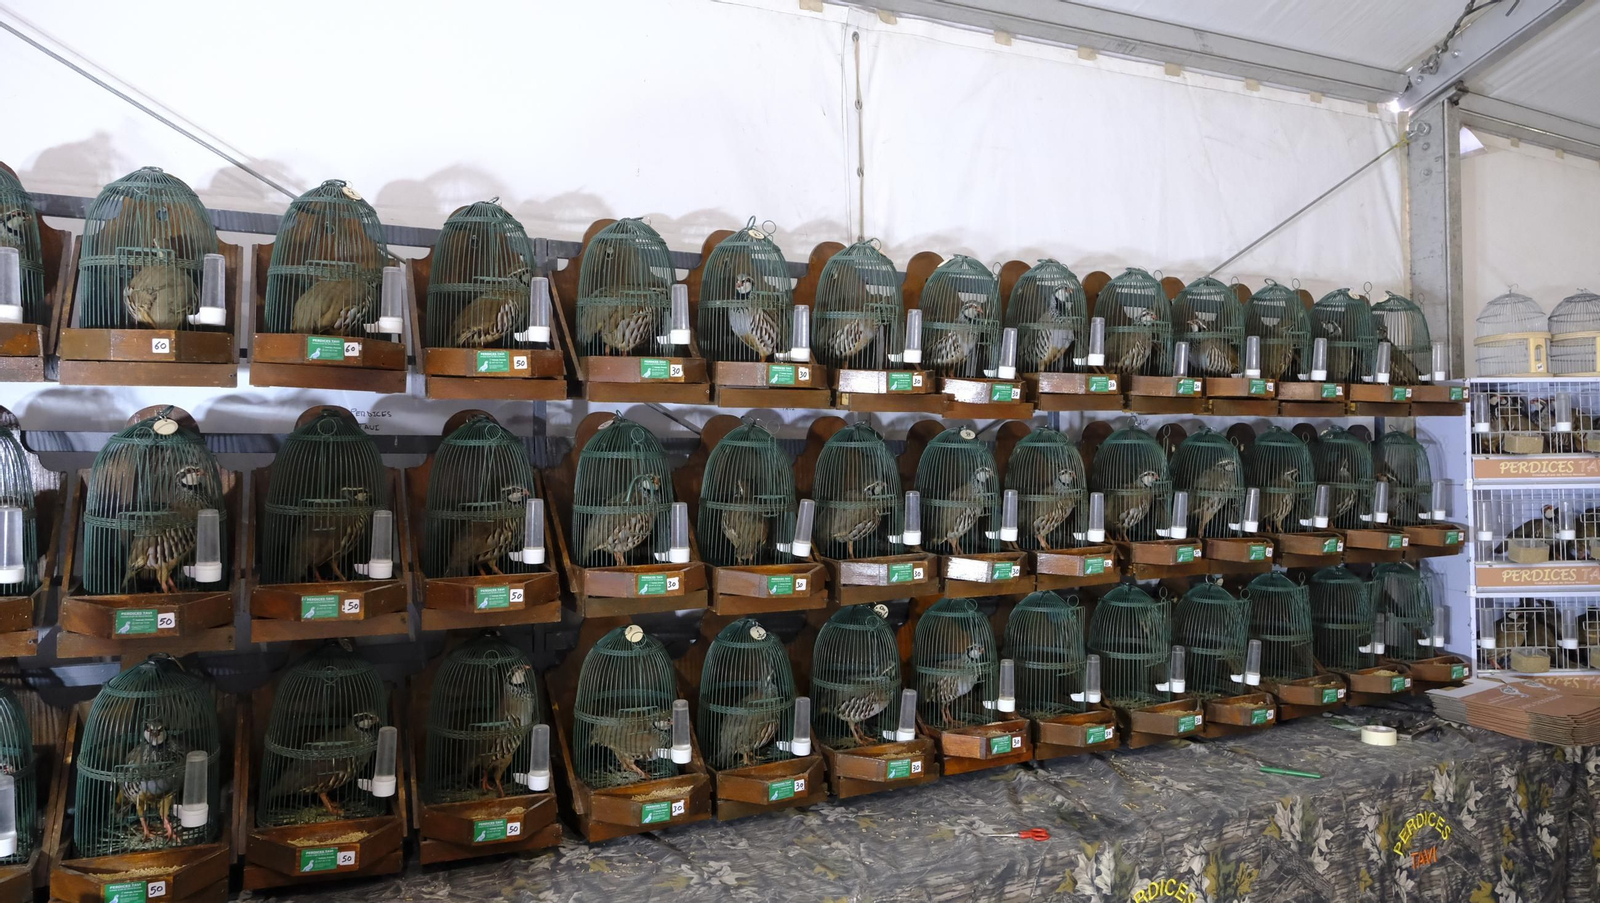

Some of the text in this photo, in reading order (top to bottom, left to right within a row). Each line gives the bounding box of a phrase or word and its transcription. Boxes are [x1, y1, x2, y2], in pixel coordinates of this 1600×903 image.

[154, 341, 167, 350] 60
[345, 345, 355, 353] 60
[672, 367, 680, 376] 30
[1500, 460, 1574, 474] PERDICES
[1502, 568, 1576, 582] PERDICES
[511, 592, 522, 600] 50
[347, 602, 359, 611] 50
[159, 618, 172, 626] 50
[796, 782, 803, 790] 30
[508, 825, 518, 834] 50
[1393, 811, 1452, 857] PERDICES
[1410, 846, 1438, 870] TAVI
[150, 886, 163, 896] 50
